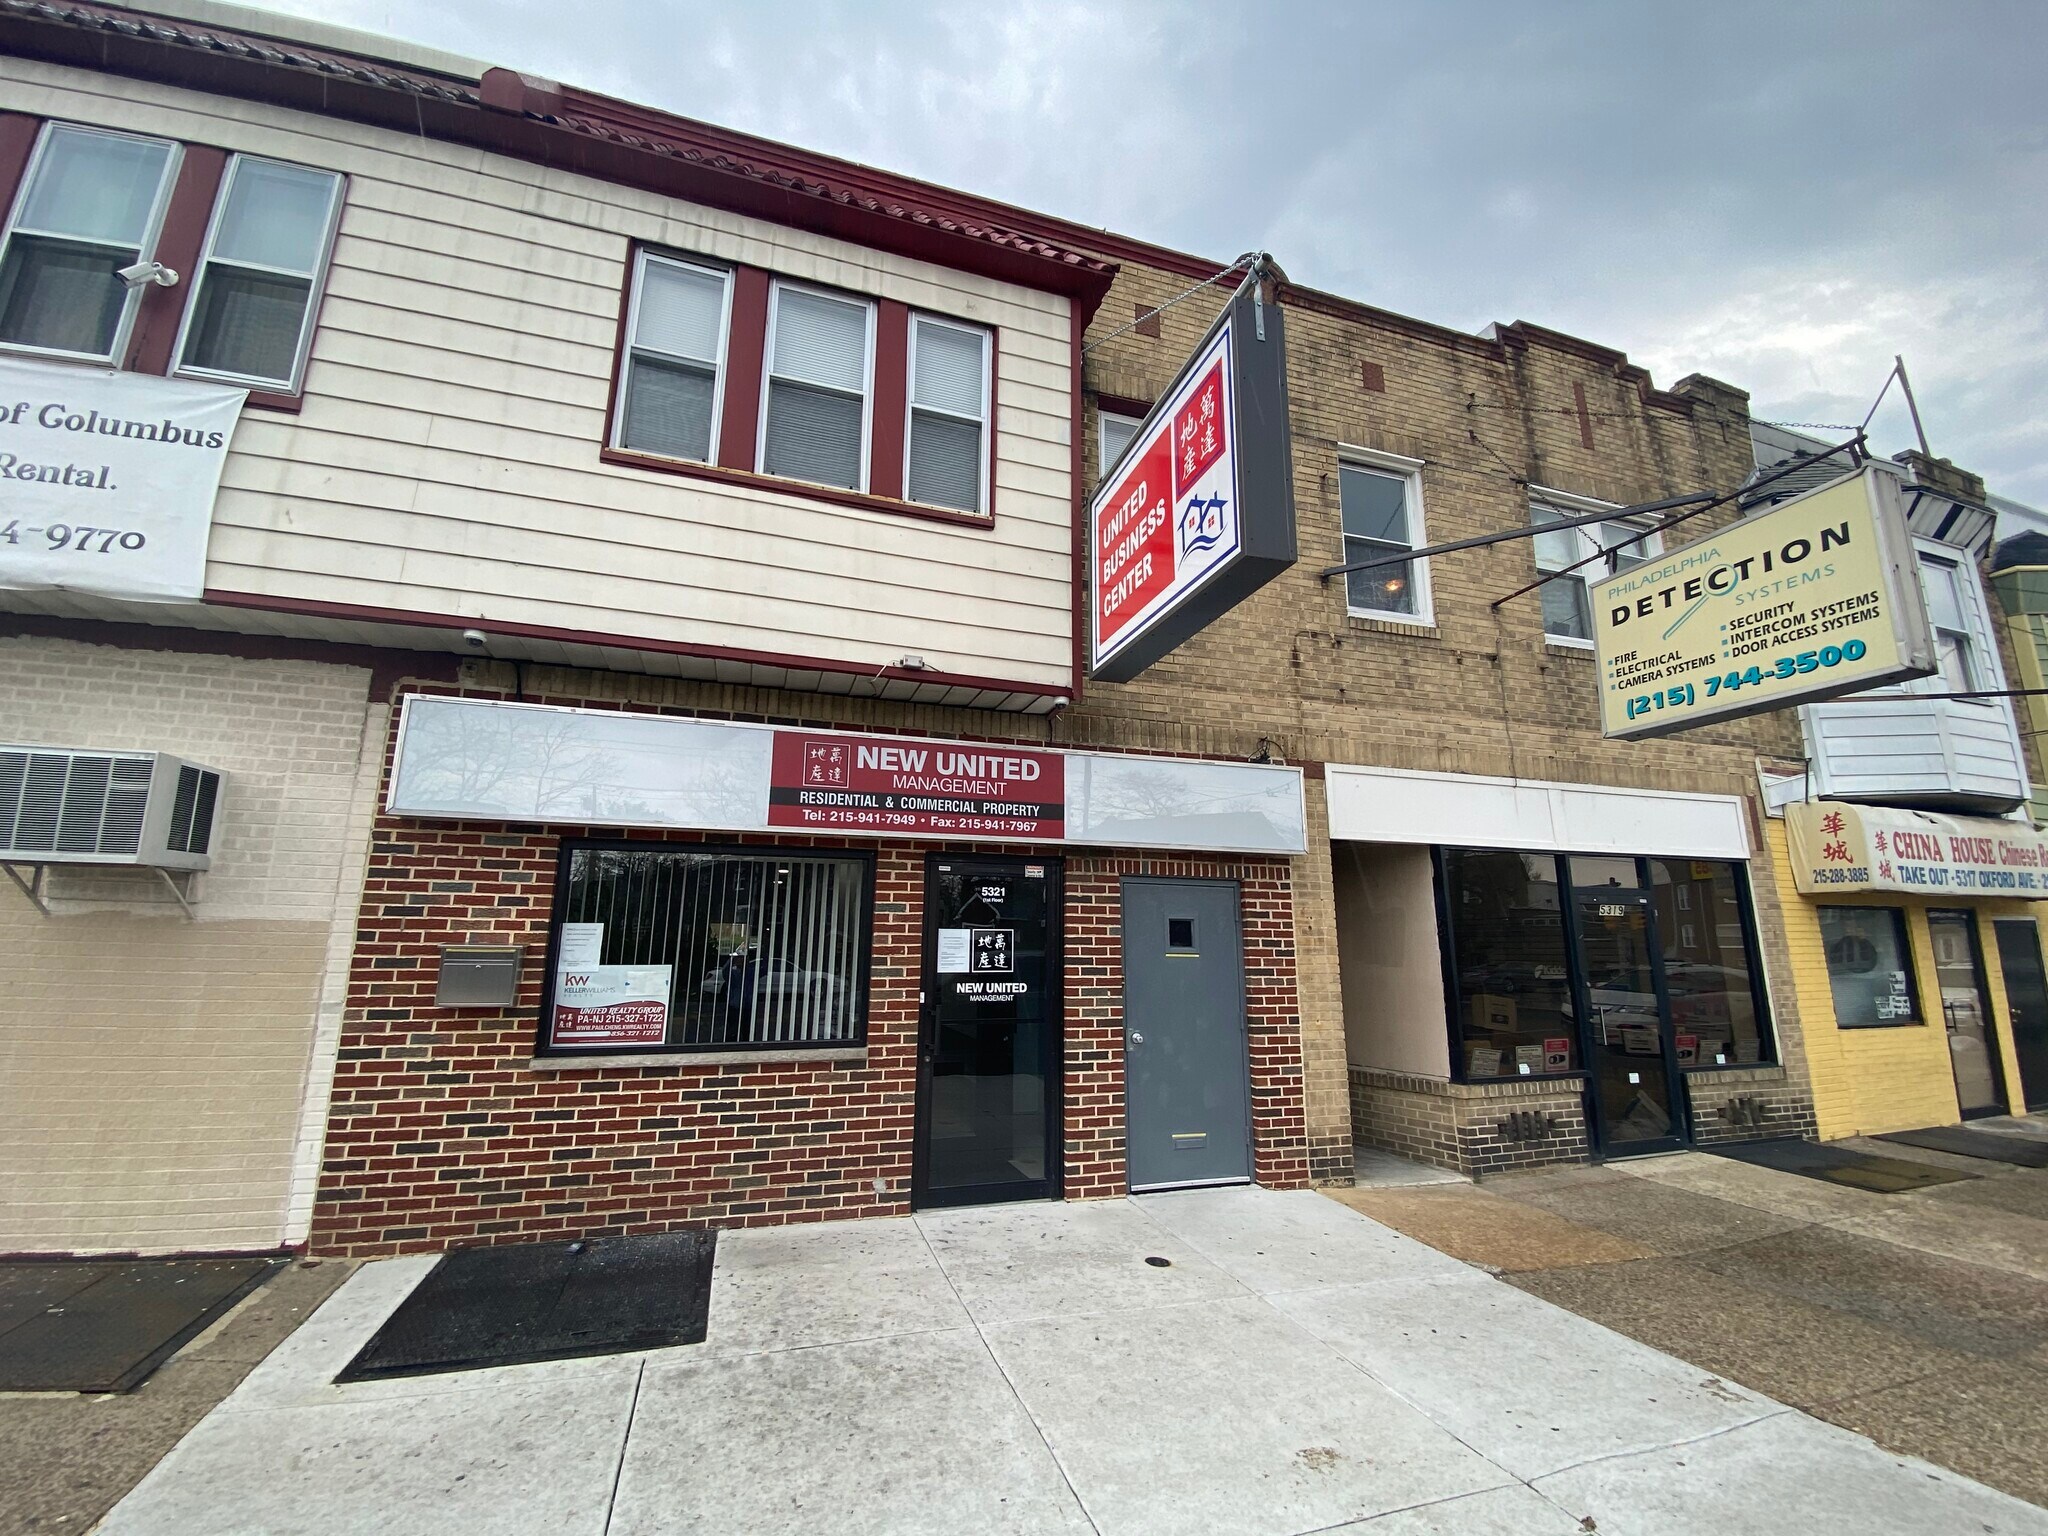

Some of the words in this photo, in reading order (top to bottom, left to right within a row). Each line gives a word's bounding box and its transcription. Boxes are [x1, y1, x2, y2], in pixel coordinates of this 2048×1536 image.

[38, 403, 224, 449] Columbus
[0, 453, 118, 490] Rental.
[1103, 480, 1148, 549] UNITED
[1103, 497, 1166, 584] BUSINESS
[1103, 553, 1153, 617] CENTER
[1608, 548, 1721, 599] PHILADELPHIA
[1611, 521, 1851, 627] DETECTION
[1735, 563, 1836, 606] SYSTEMS
[1729, 601, 1795, 631] SECURITY
[1730, 613, 1806, 645] INTERCOM
[1811, 590, 1879, 621] SYSTEMS
[1732, 638, 1768, 658] DOOR
[1772, 624, 1818, 648] ACCESS
[1822, 606, 1880, 633] SYSTEMS
[1614, 650, 1638, 666] FIRE
[1615, 650, 1682, 678] ELECTRICAL
[1618, 670, 1663, 690] CAMERA
[1666, 653, 1716, 677] SYSTEMS
[1626, 683, 1695, 719] (215)
[1704, 639, 1867, 697] 744-3500
[857, 745, 928, 773] NEW
[936, 752, 1041, 781] UNITED
[893, 774, 1008, 796] MANAGEMENT
[800, 792, 879, 808] RESIDENTIAL
[885, 796, 894, 808] &
[901, 797, 977, 813] COMMERCIAL
[983, 802, 1040, 817] PROPERTY
[803, 809, 826, 822] Tel:
[829, 811, 916, 826] 215-941-7949
[931, 816, 956, 828] Fax:
[959, 818, 1038, 832] 215-941-7967
[1893, 831, 1944, 863] CHINA
[1949, 836, 1996, 865] HOUSE
[1999, 840, 2038, 868] Chinese
[982, 886, 1005, 897] 5321
[1813, 867, 1869, 884] 215-288-3885
[1897, 866, 1927, 885] TAKE
[1928, 868, 1949, 886] OUT
[1956, 872, 1976, 887] 5317
[1979, 871, 2016, 888] OXFORD
[2018, 873, 2038, 889] AVE.
[1599, 905, 1625, 916] 5319
[565, 972, 590, 986] kw
[956, 983, 983, 993] NEW
[986, 983, 1027, 993] UNITED
[577, 1014, 604, 1023] PA-NJ
[606, 1013, 663, 1023] 215-327-1722
[608, 1007, 637, 1015] REALTY
[637, 1006, 664, 1015] GROUP
